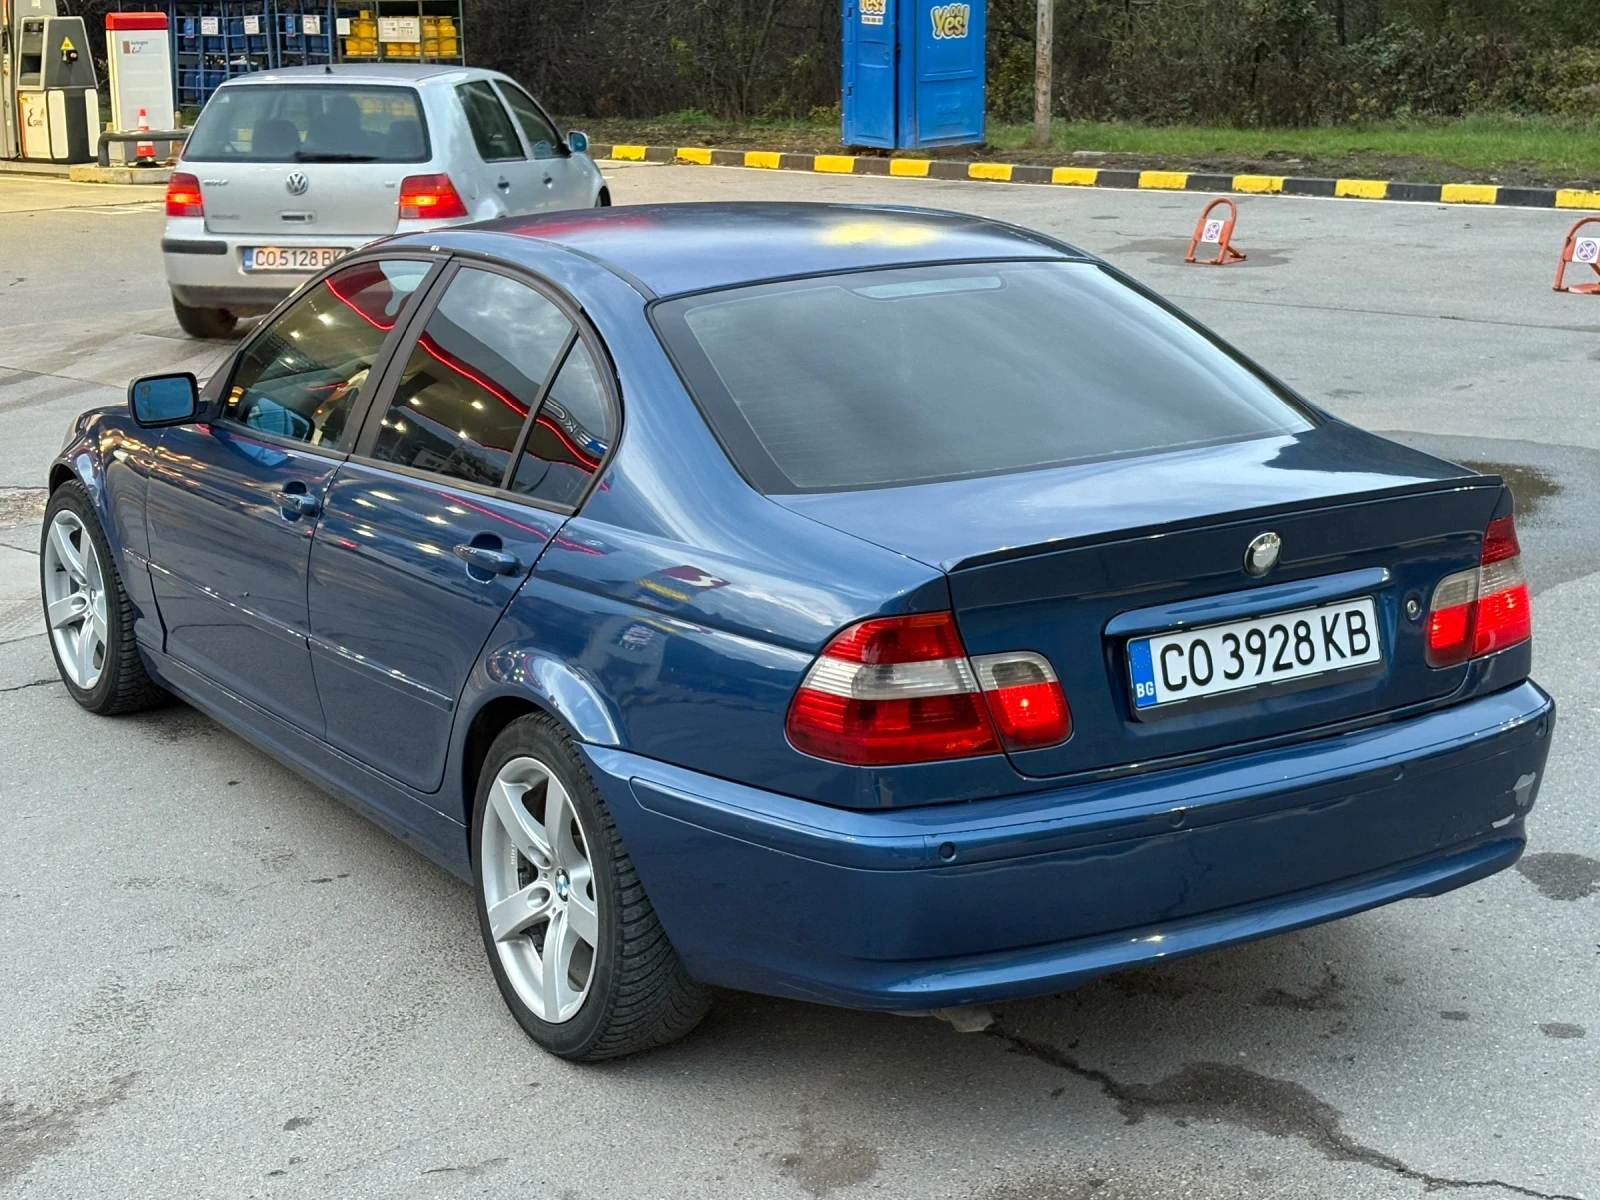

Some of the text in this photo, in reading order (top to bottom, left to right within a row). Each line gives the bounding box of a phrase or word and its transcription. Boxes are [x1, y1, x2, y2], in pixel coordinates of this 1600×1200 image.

[933, 6, 968, 36] Yes!
[256, 250, 276, 266] CO
[280, 250, 319, 267] 5128
[1160, 610, 1371, 692] CO 3928 KB
[1136, 681, 1155, 698] BG
